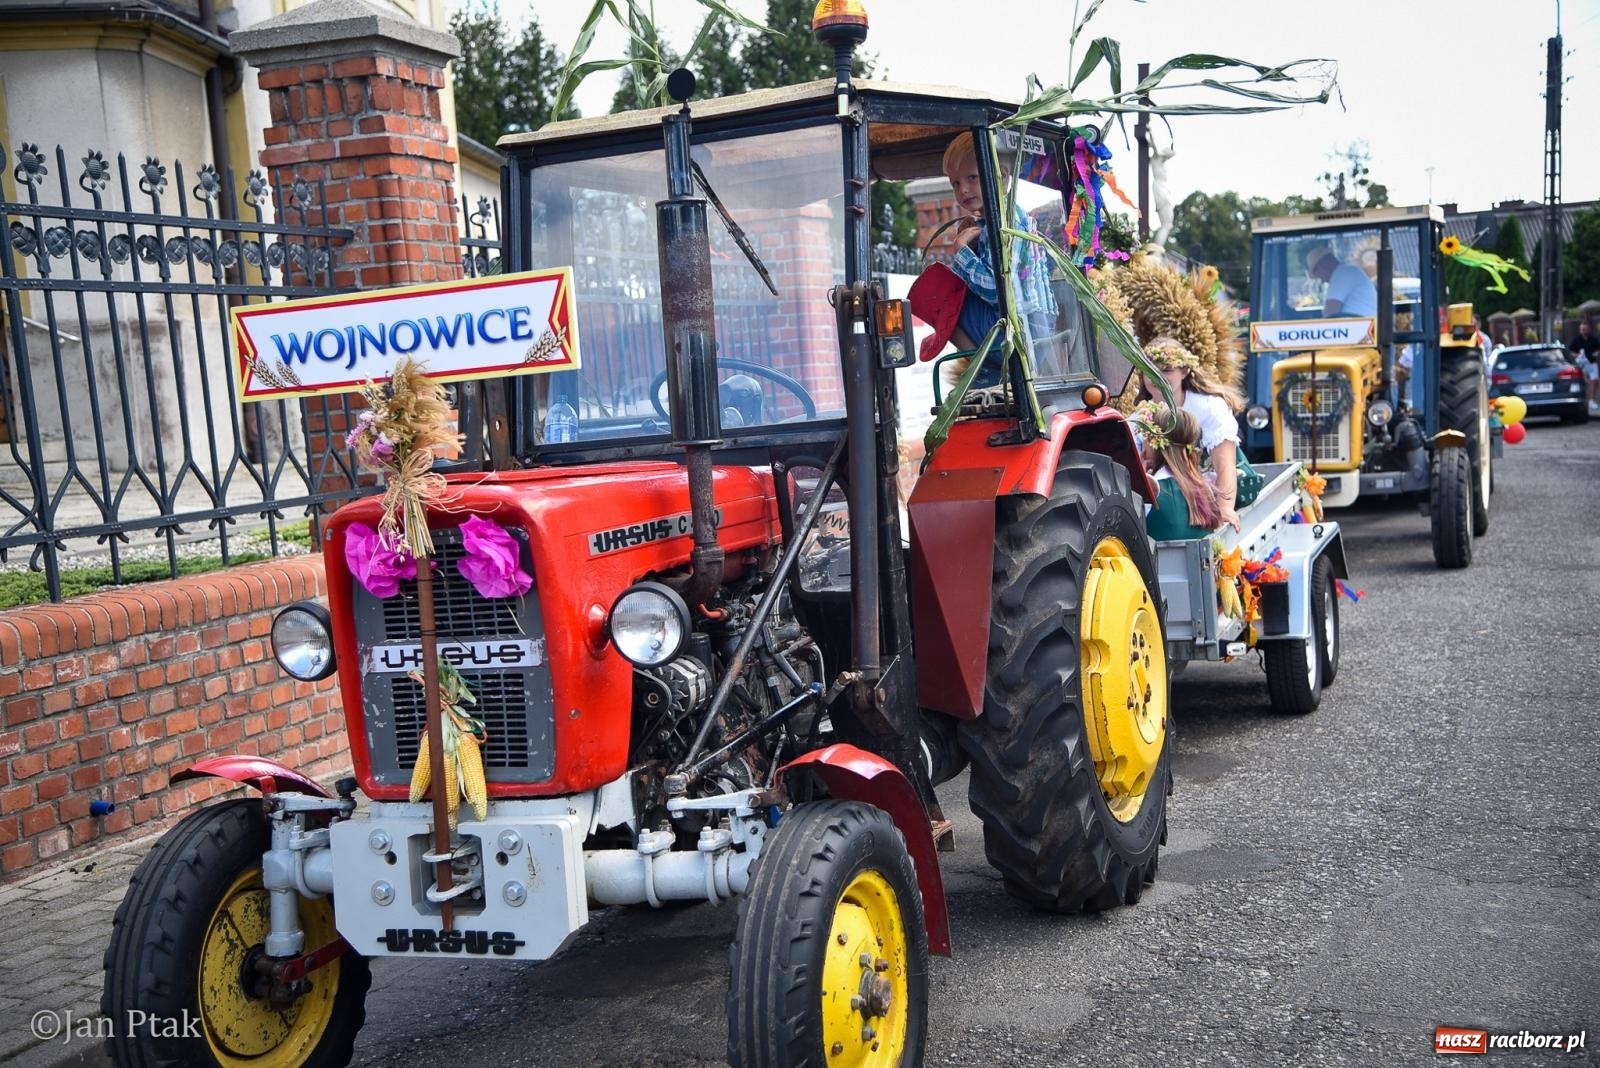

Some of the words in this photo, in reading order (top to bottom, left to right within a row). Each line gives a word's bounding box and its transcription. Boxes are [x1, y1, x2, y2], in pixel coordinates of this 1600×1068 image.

[271, 306, 533, 369] WOJNOWICE
[1278, 328, 1349, 341] BORUCIN
[594, 519, 672, 553] URSUS
[377, 928, 526, 956] URSUS
